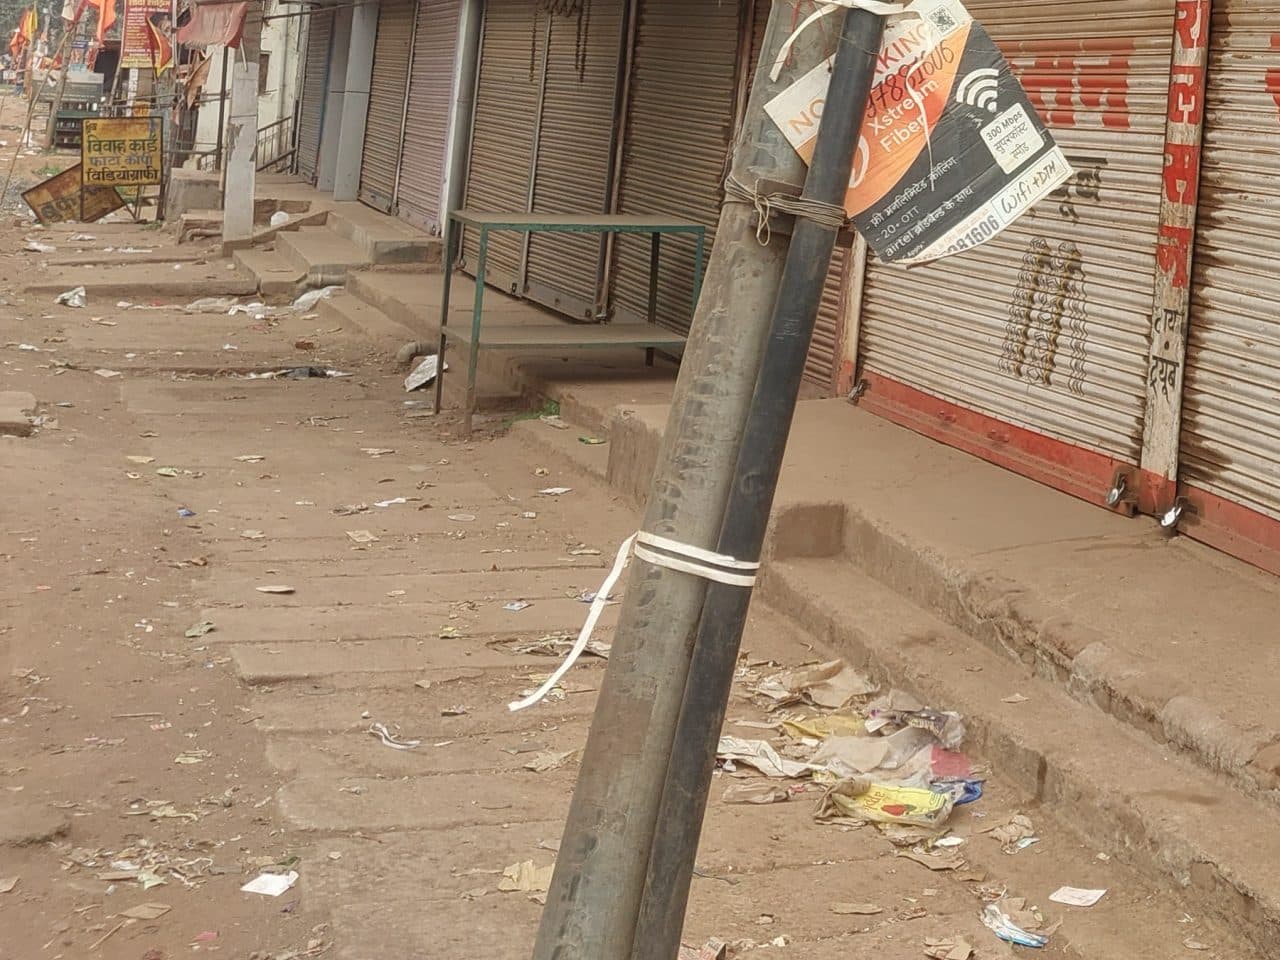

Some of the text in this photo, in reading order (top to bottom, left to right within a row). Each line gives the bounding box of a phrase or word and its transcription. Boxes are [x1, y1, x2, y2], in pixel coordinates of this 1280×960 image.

[985, 123, 1003, 142] 300
[1002, 109, 1024, 133] Mbps
[86, 132, 158, 155] विवाह कार्ड
[884, 231, 913, 258] airtel
